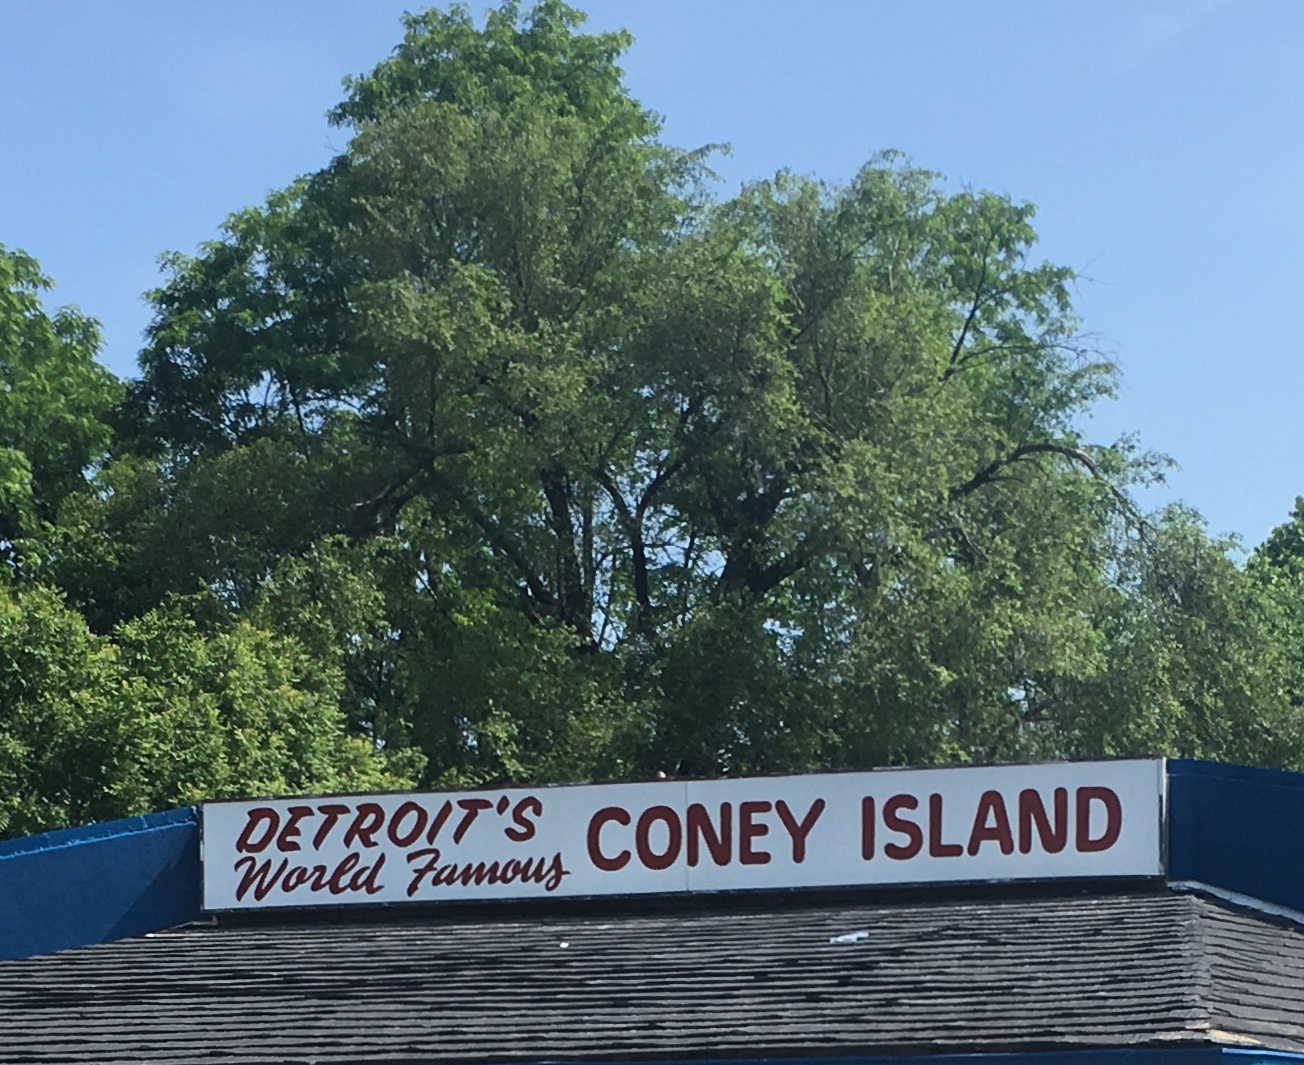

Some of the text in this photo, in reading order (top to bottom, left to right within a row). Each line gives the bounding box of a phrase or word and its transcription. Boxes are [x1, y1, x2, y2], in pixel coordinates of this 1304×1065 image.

[236, 796, 543, 854] DETROIT'S
[586, 785, 1124, 873] CONEY ISLAND
[232, 845, 571, 902] World Famous
